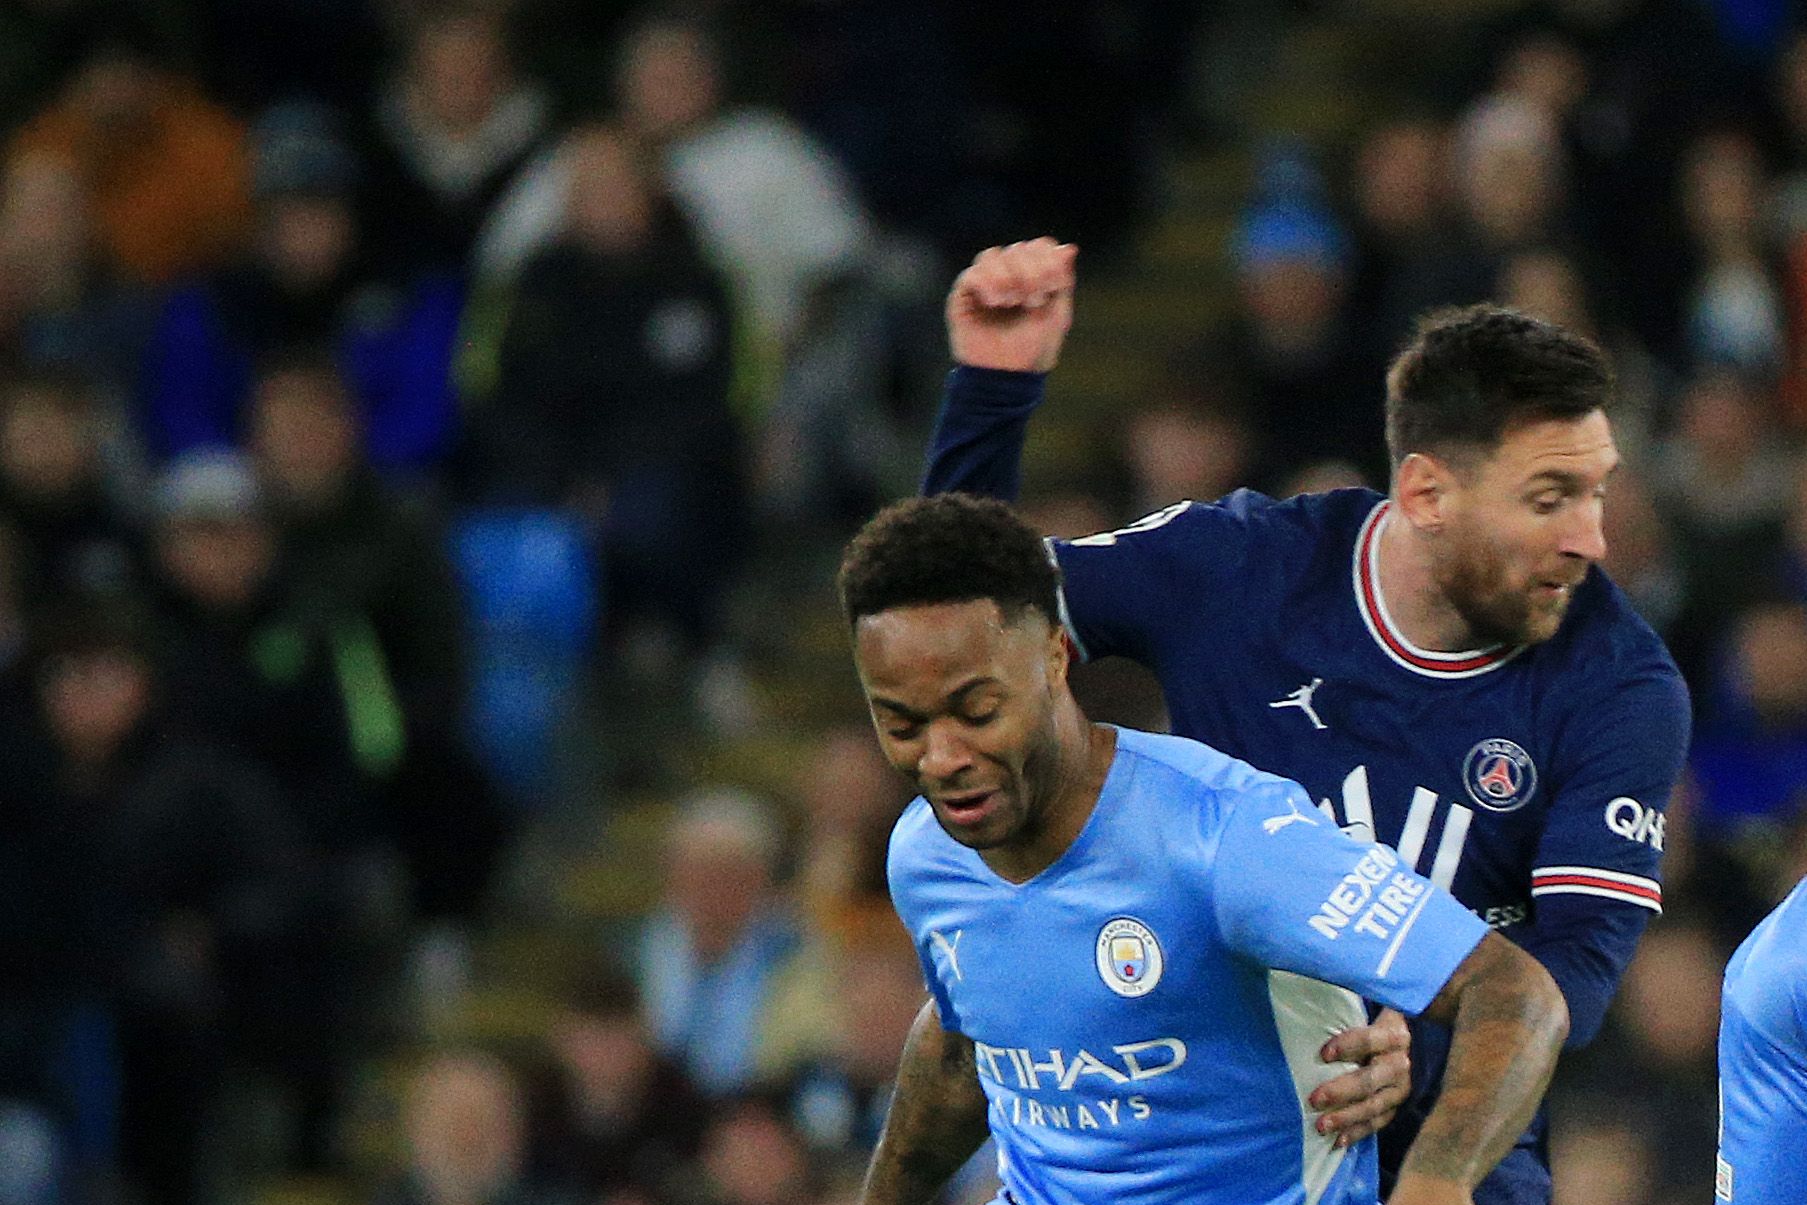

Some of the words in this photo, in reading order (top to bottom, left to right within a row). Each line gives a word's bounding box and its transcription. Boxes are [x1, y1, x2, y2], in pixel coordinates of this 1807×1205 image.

[1307, 843, 1399, 940] NEXEN
[1354, 871, 1425, 939] TIRE
[1100, 921, 1154, 947] MANCHESTER
